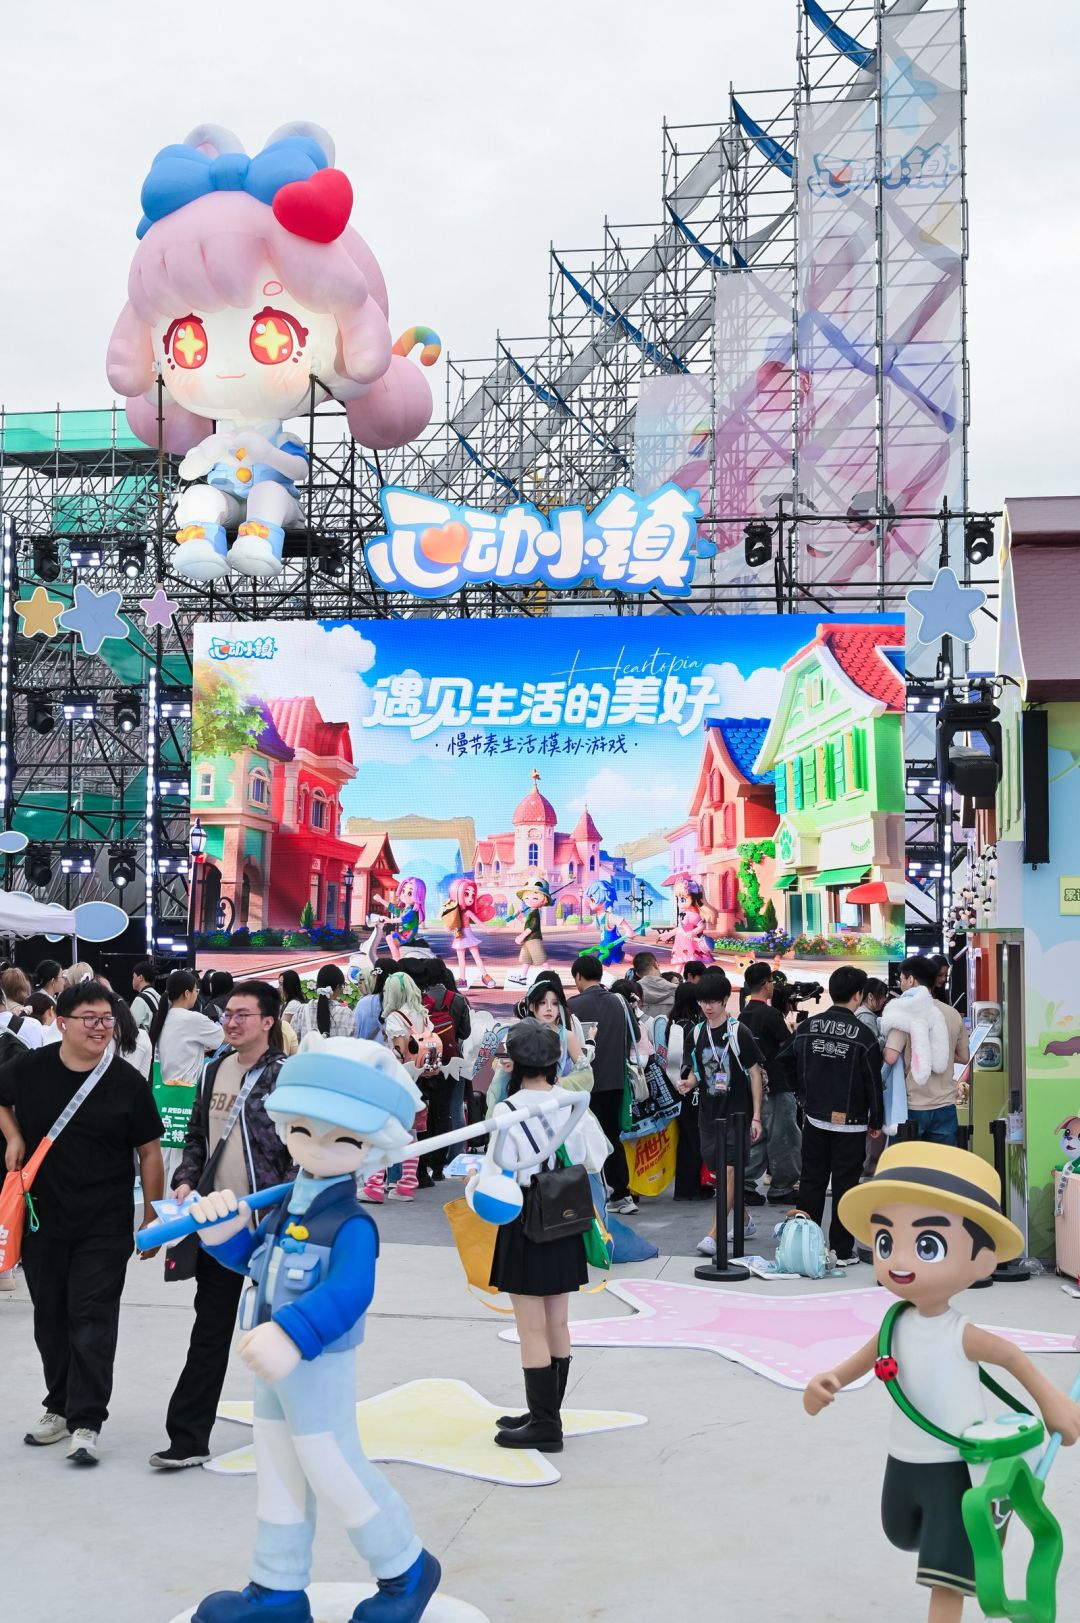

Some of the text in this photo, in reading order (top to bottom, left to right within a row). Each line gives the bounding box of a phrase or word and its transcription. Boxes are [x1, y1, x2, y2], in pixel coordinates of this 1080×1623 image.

[367, 488, 696, 589] 心动小镇
[551, 645, 701, 686] Heartopia
[362, 676, 721, 740] 遇见生活的美好
[810, 1019, 860, 1039] EVISU
[159, 1129, 189, 1143] 上特
